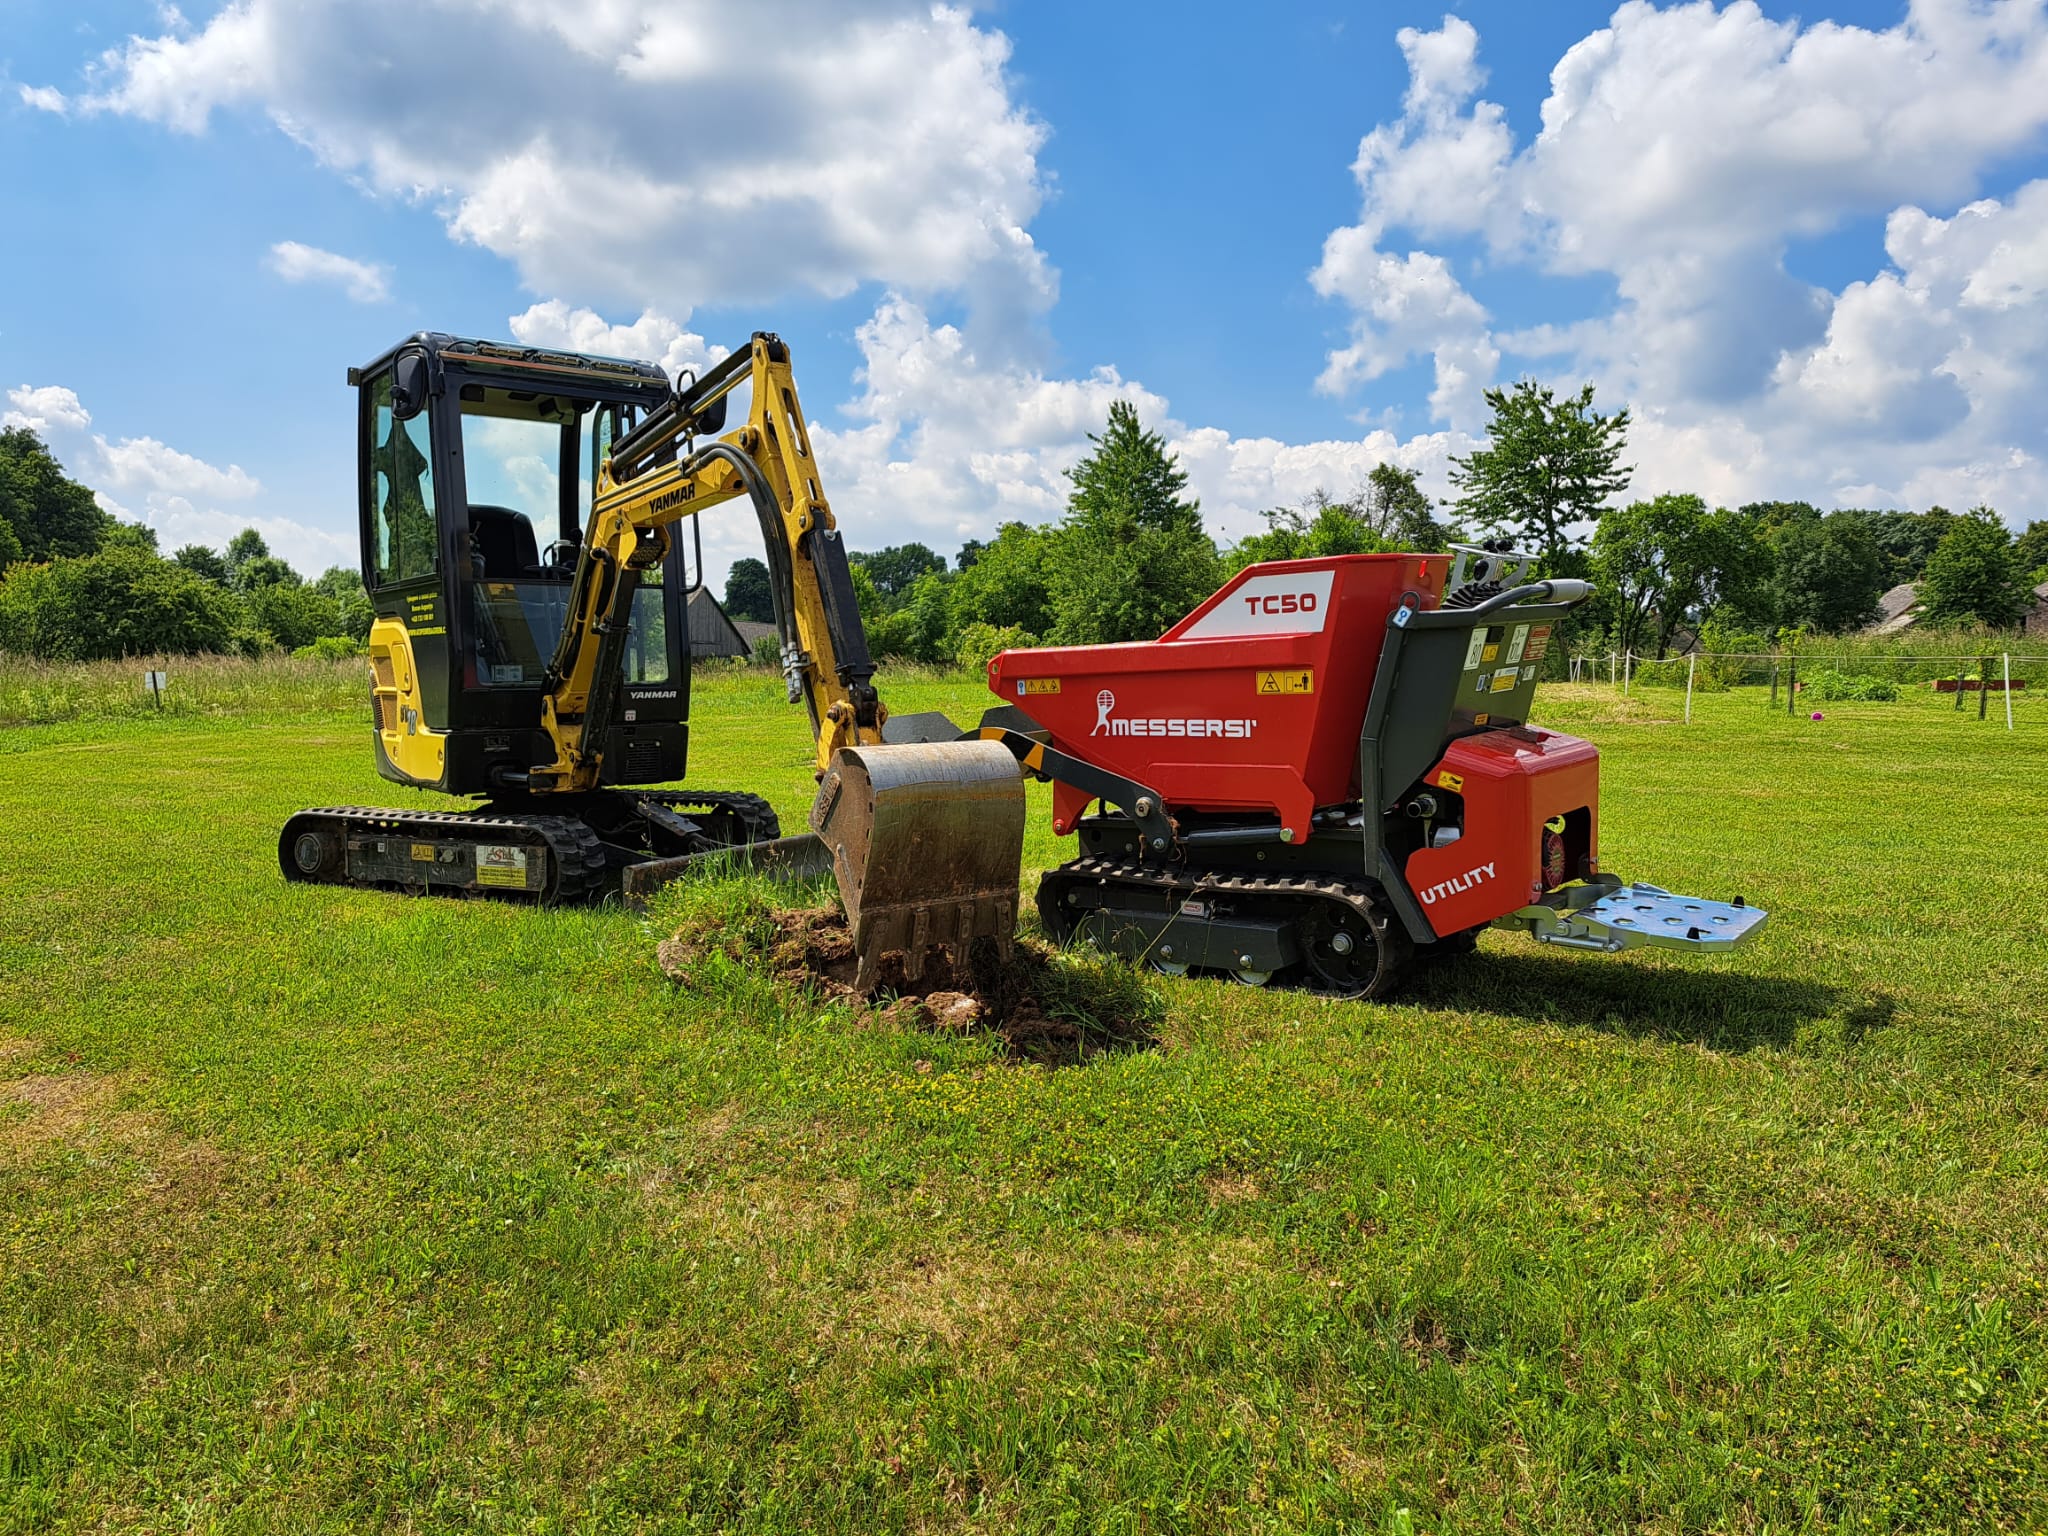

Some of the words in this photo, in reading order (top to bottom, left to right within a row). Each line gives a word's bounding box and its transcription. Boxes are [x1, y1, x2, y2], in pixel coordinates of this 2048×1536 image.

[649, 482, 695, 514] YANMAR
[1245, 593, 1317, 615] TC50
[630, 690, 677, 699] YANMAR
[1420, 862, 1496, 904] UTILITY
